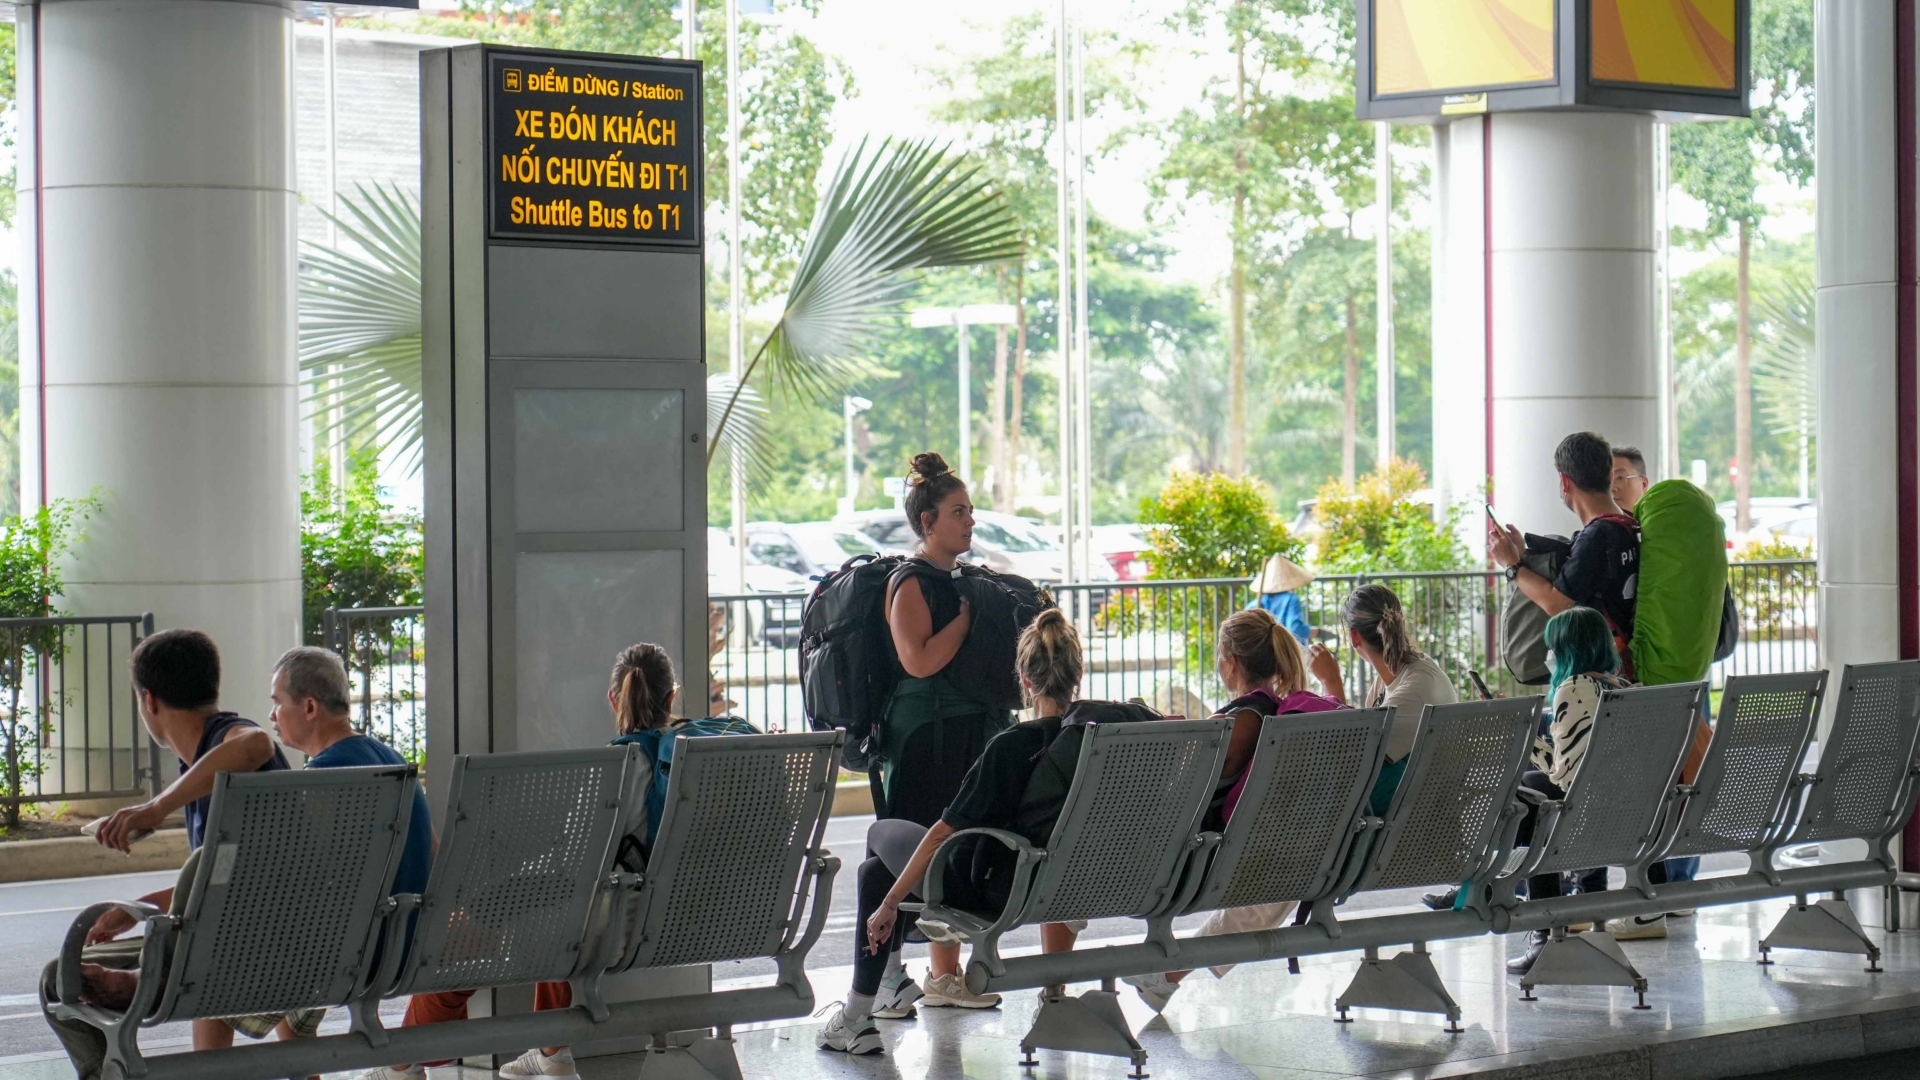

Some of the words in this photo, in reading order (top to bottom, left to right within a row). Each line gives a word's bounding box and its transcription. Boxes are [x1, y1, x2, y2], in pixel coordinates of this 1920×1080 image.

[527, 67, 569, 93] ĐIỂM
[572, 73, 620, 97] DỪNG
[622, 80, 629, 98] /
[632, 81, 684, 101] Station
[515, 109, 545, 139] XE
[549, 105, 597, 142] ĐÓN
[603, 110, 676, 146] KHÁCH
[502, 143, 541, 184] NỐI
[546, 150, 635, 189] CHUYẾN
[639, 162, 661, 190] ĐI
[665, 164, 687, 191] T1
[510, 196, 583, 227] Shuttle
[588, 199, 628, 229] Bus
[632, 203, 653, 230] to
[657, 203, 680, 231] T1
